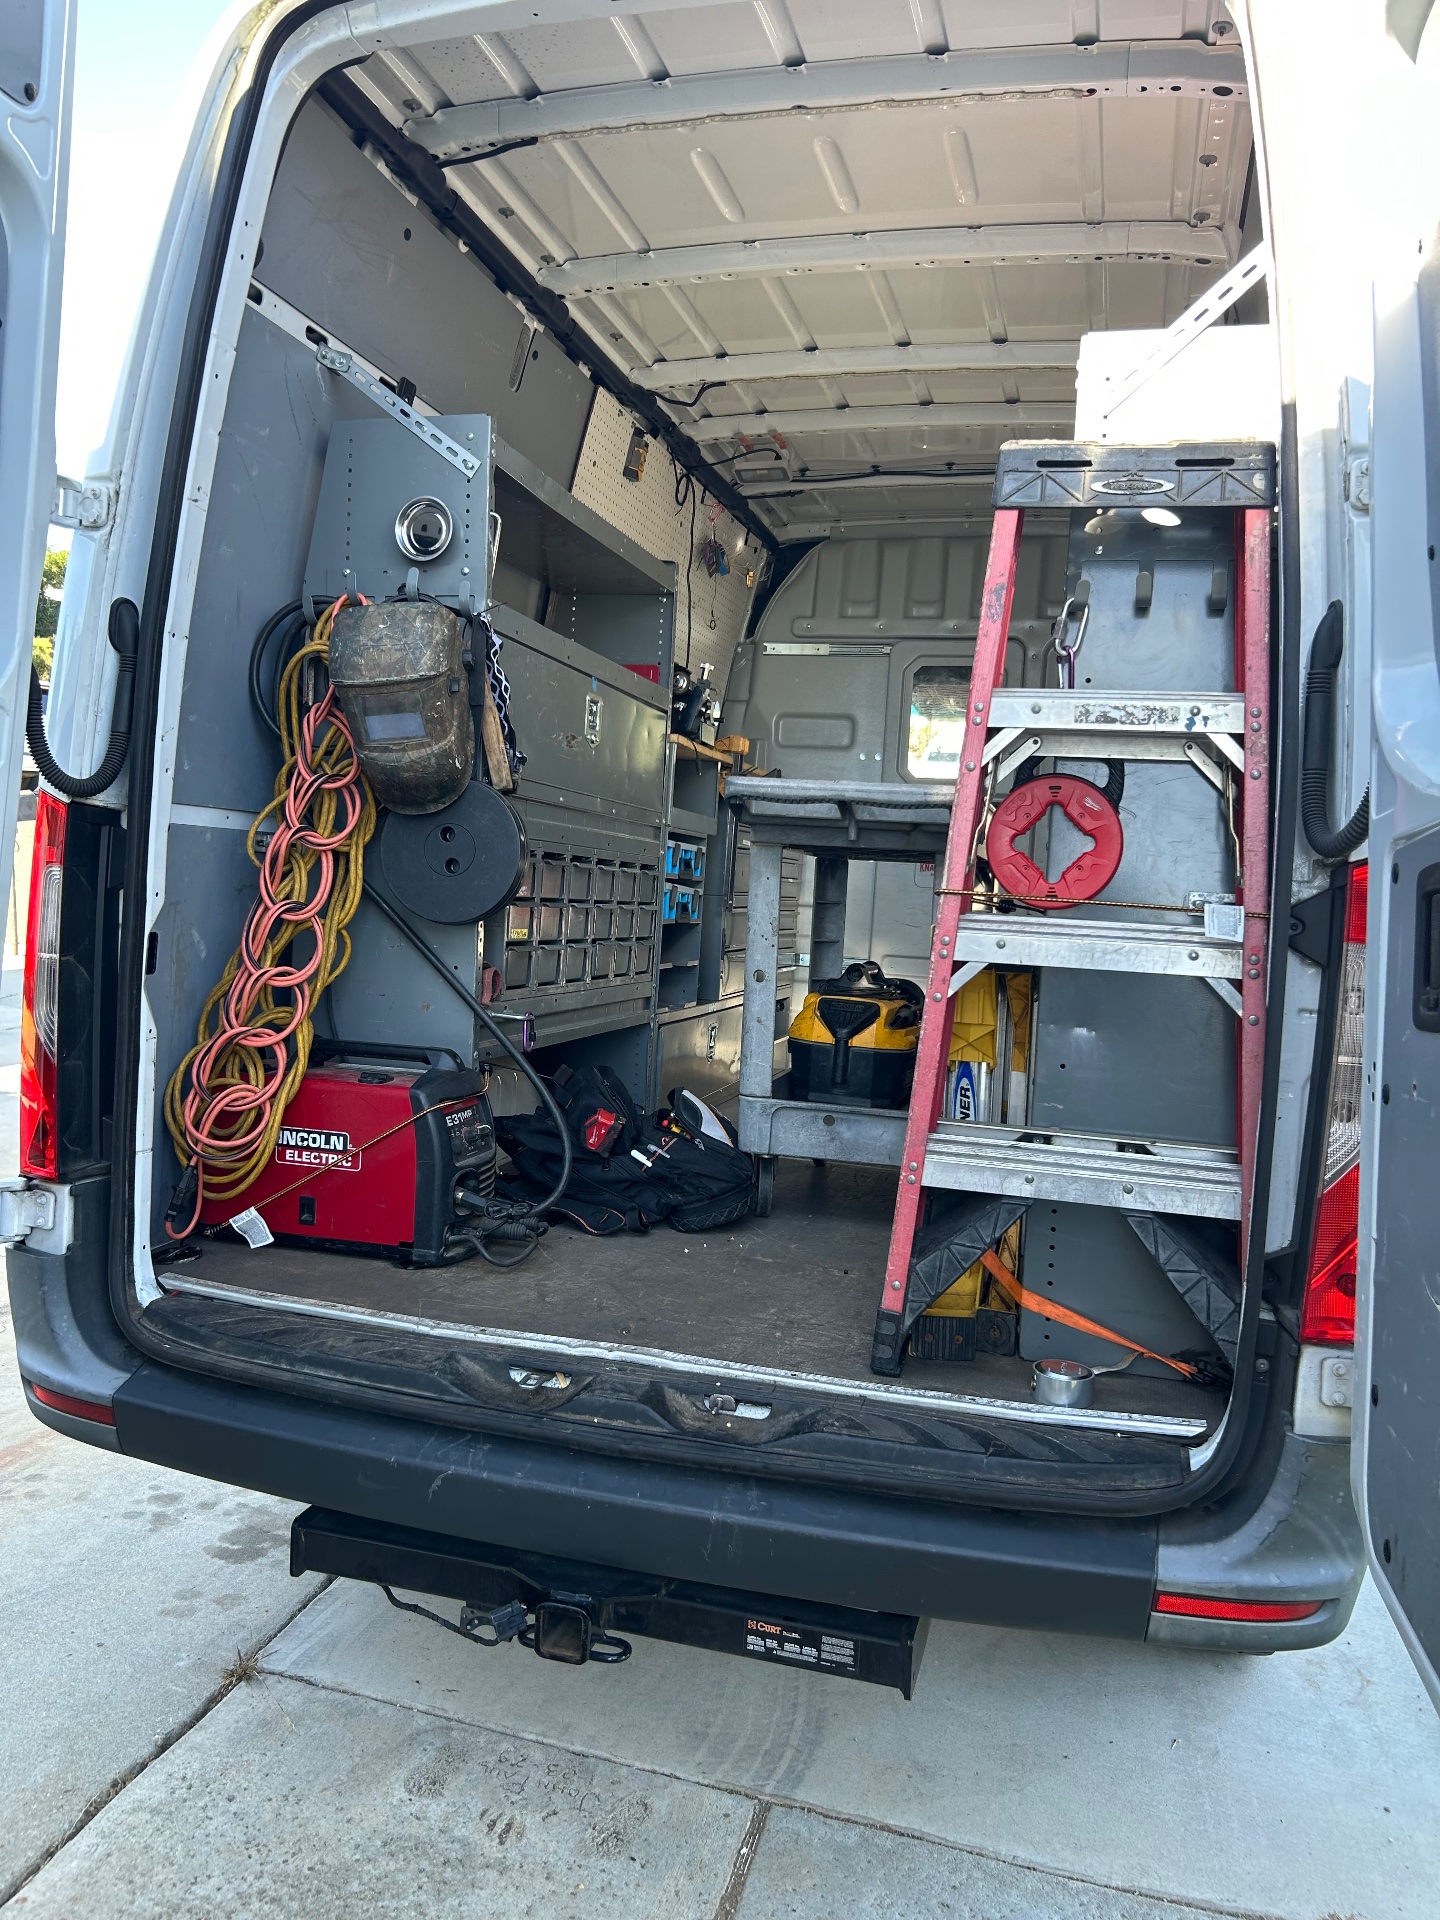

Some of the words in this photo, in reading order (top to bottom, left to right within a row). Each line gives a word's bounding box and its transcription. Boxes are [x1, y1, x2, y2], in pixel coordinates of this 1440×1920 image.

[920, 863, 935, 872] KNA
[960, 1086, 970, 1120] NER
[278, 1130, 344, 1151] INCOLN
[285, 1149, 352, 1167] ELECTRIC
[757, 1622, 782, 1634] CURT
